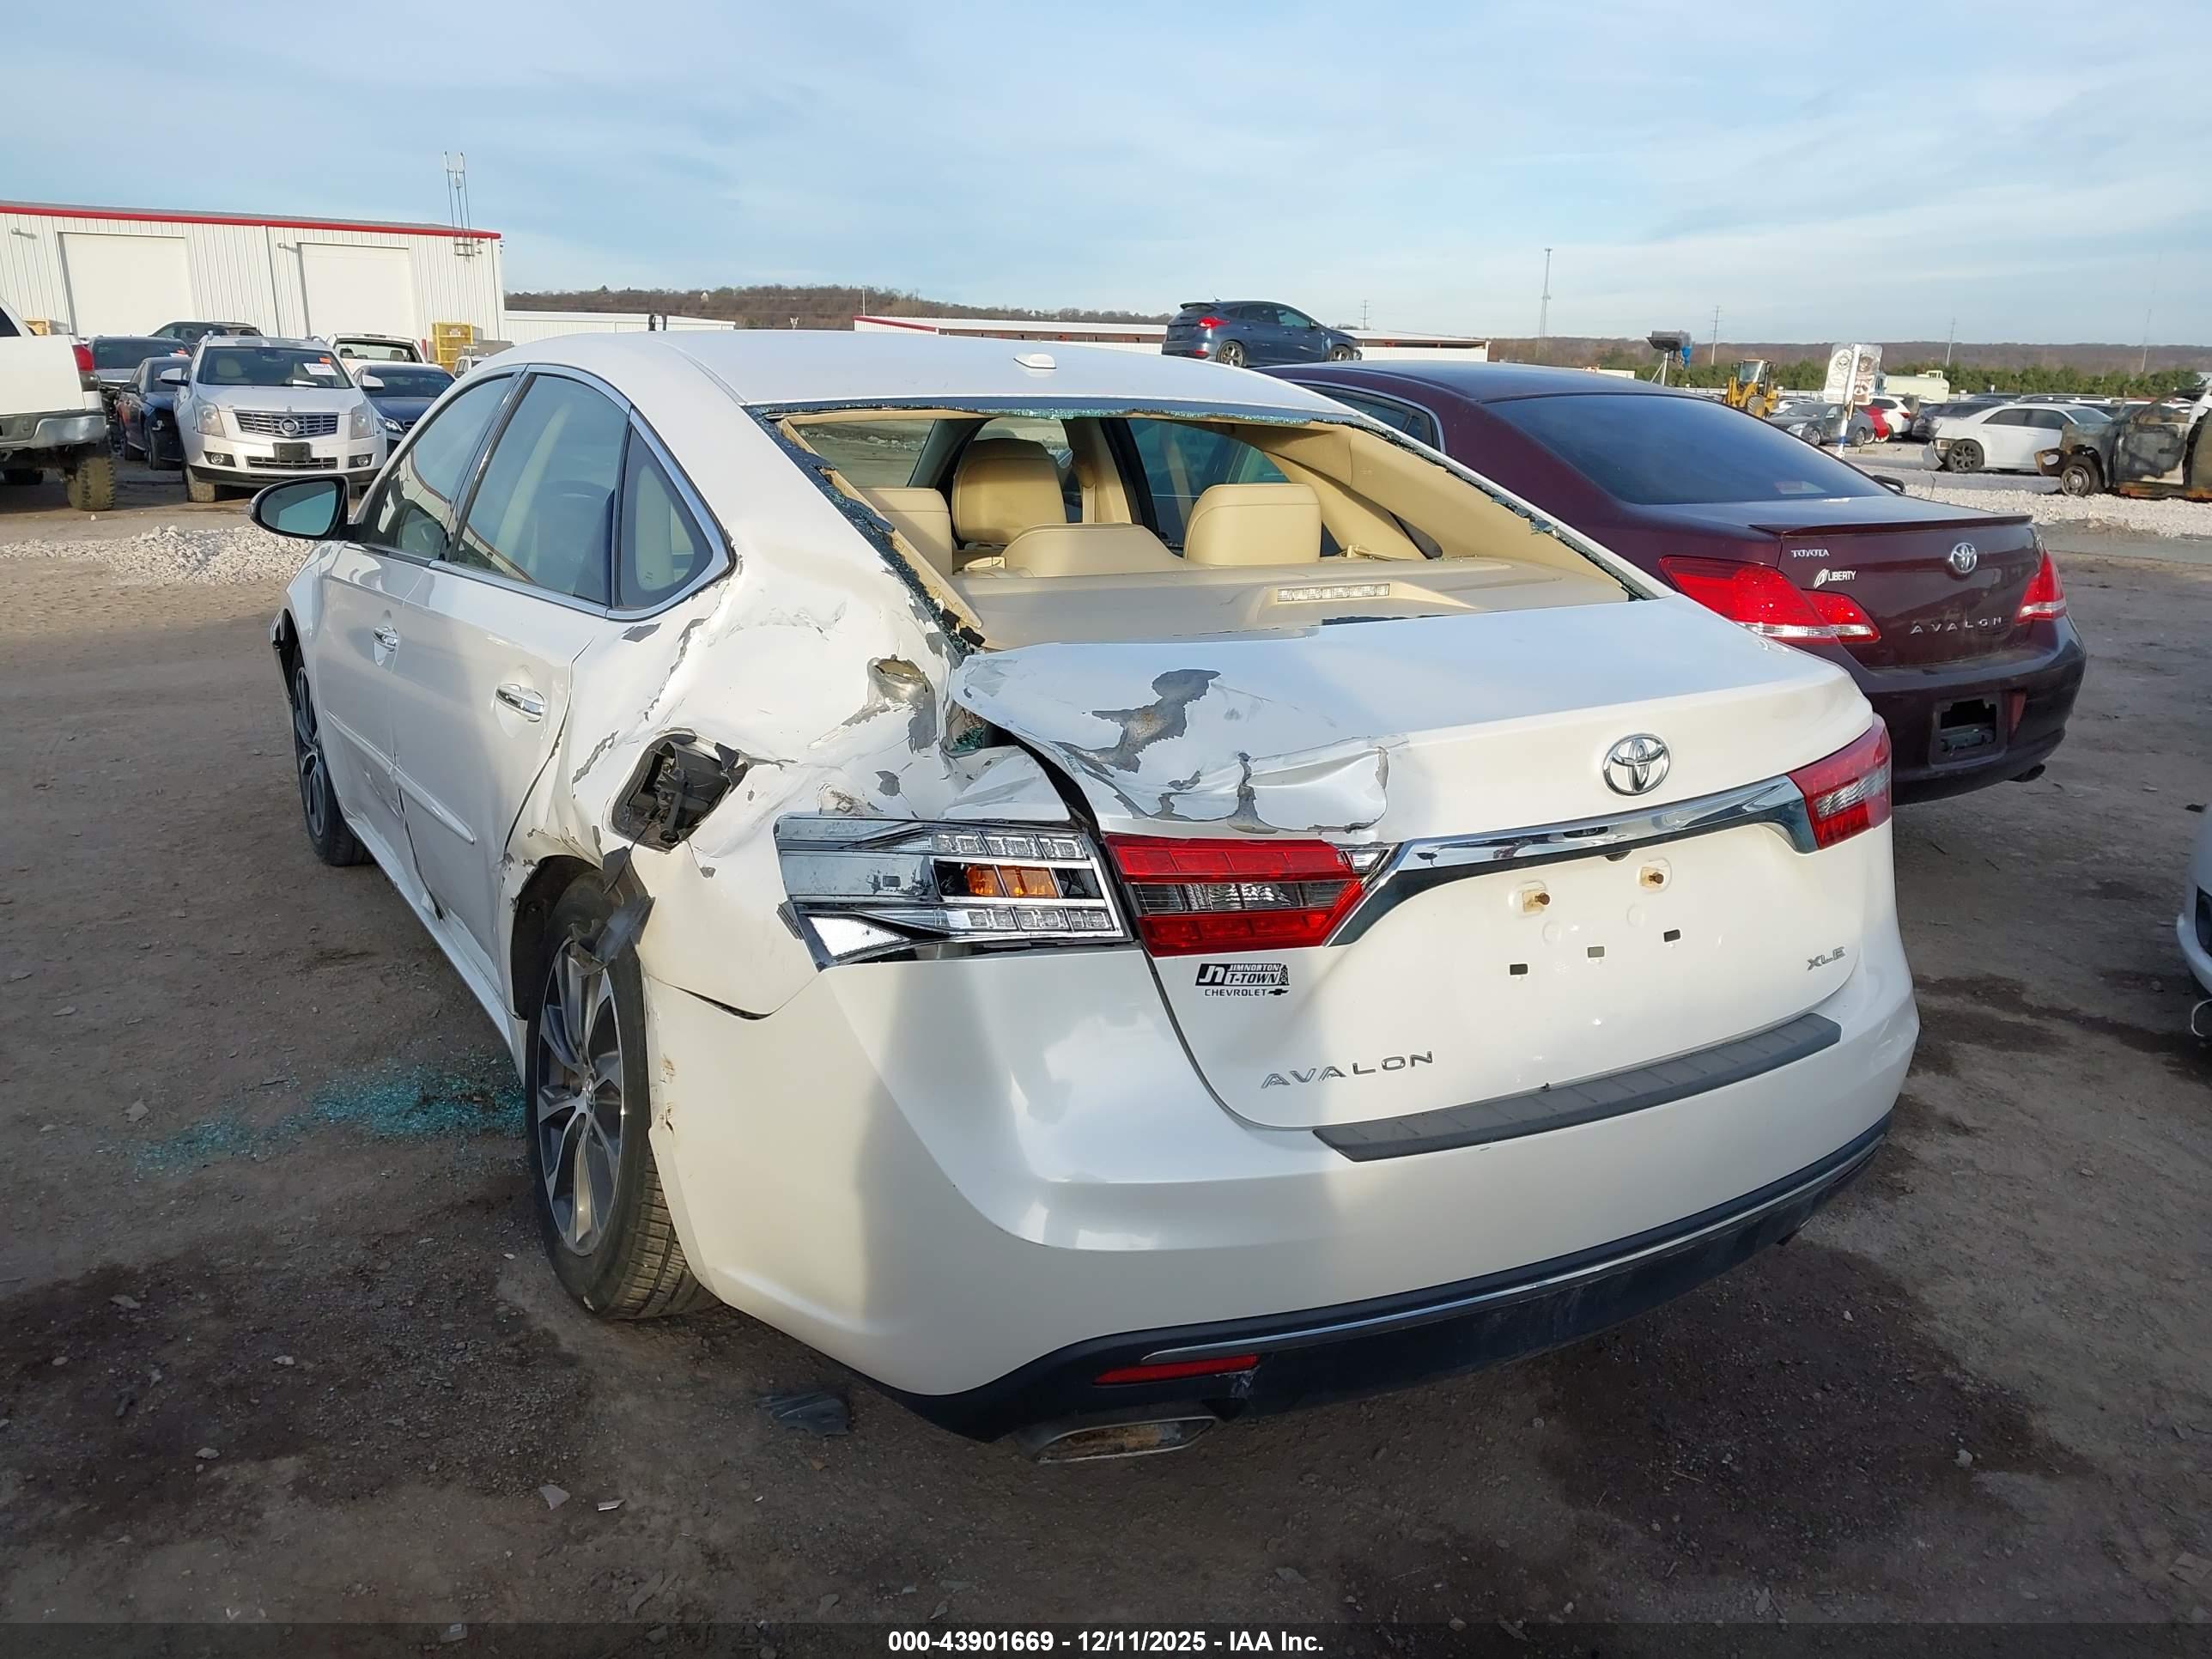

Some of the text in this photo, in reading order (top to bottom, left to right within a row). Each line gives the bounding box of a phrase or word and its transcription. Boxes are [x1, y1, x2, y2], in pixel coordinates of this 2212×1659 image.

[1790, 550, 1830, 558] TOYOTA
[1828, 570, 1856, 581] LIBERTY
[1910, 617, 2002, 635] AVALON
[1807, 945, 1846, 971] XLE
[1229, 974, 1279, 983] T-TOWN
[1261, 1050, 1433, 1089] AVALON
